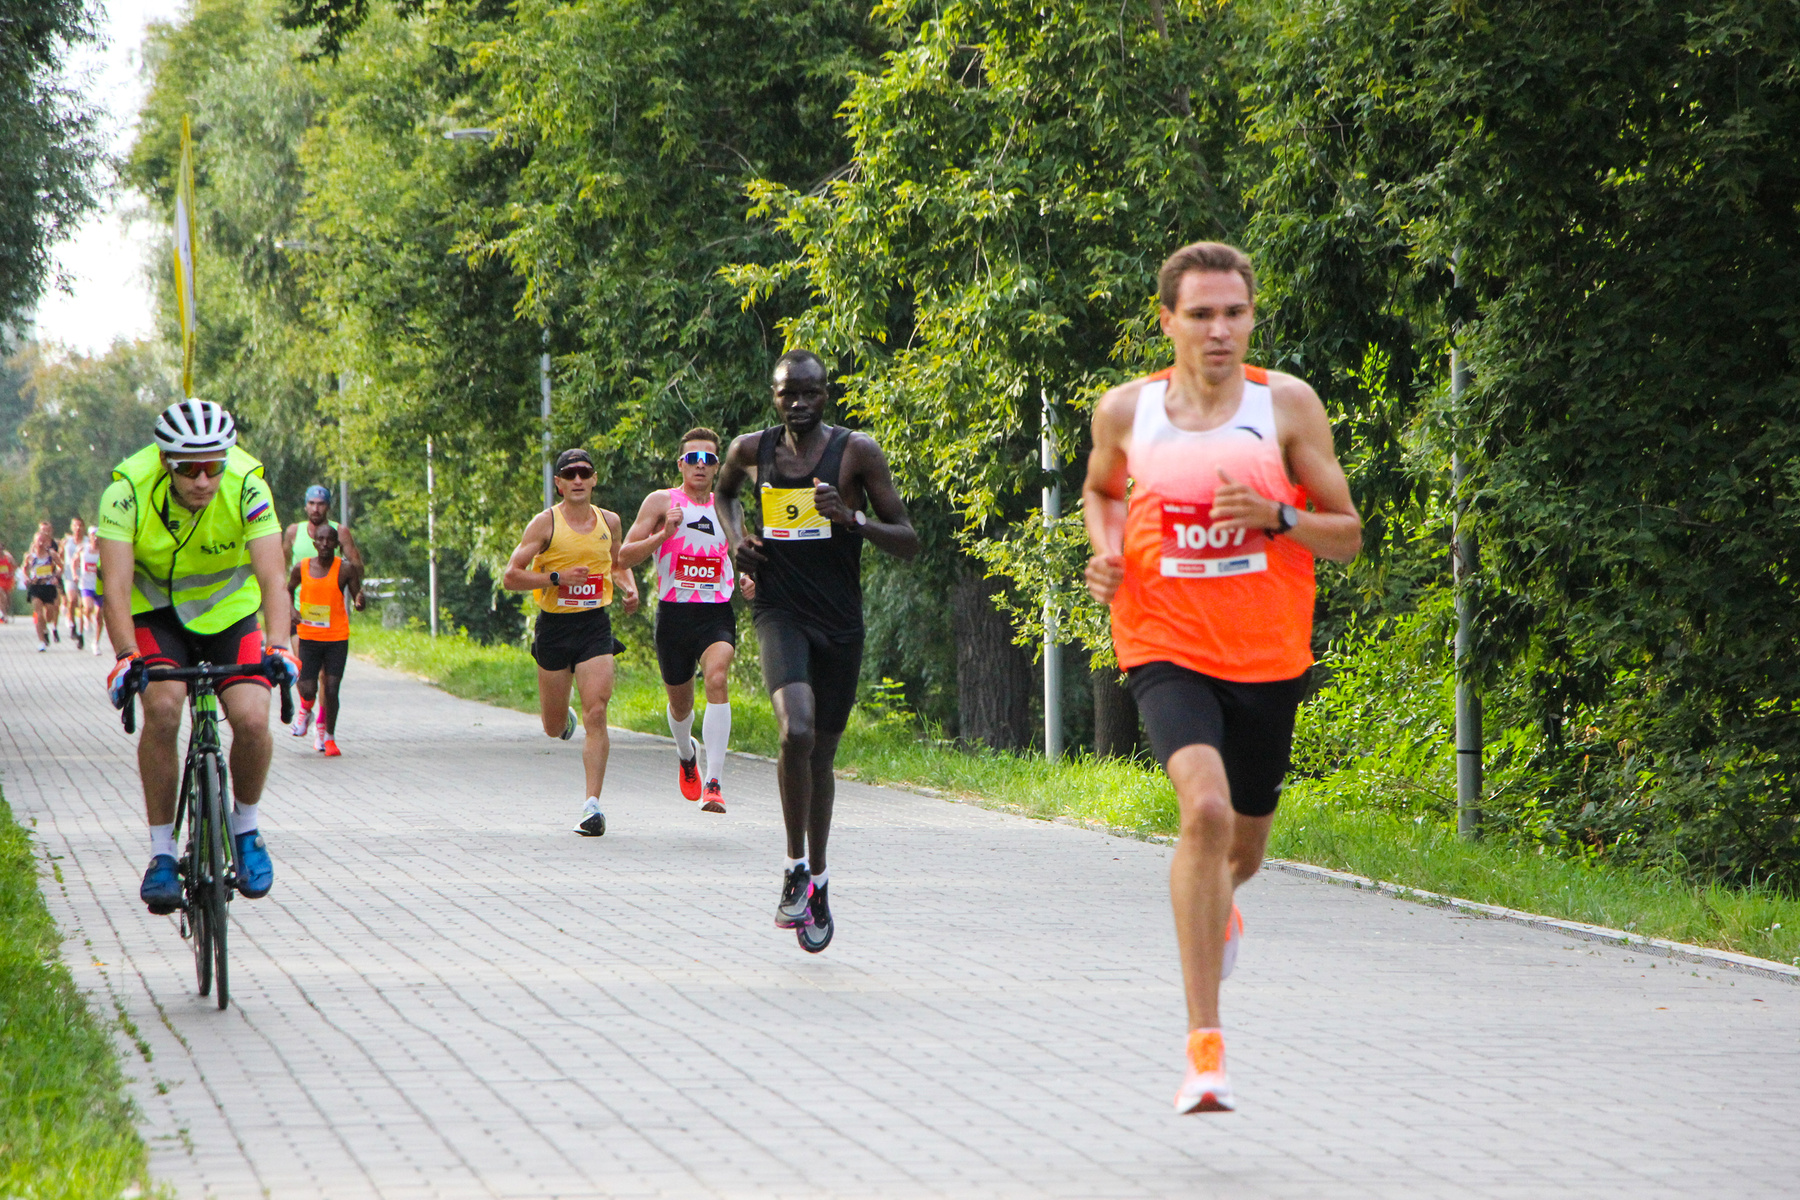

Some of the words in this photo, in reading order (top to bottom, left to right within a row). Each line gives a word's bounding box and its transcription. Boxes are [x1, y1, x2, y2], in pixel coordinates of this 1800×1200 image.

[786, 504, 799, 520] 9
[1173, 523, 1246, 549] 1007
[683, 565, 715, 578] 1005
[568, 584, 596, 596] 1001
